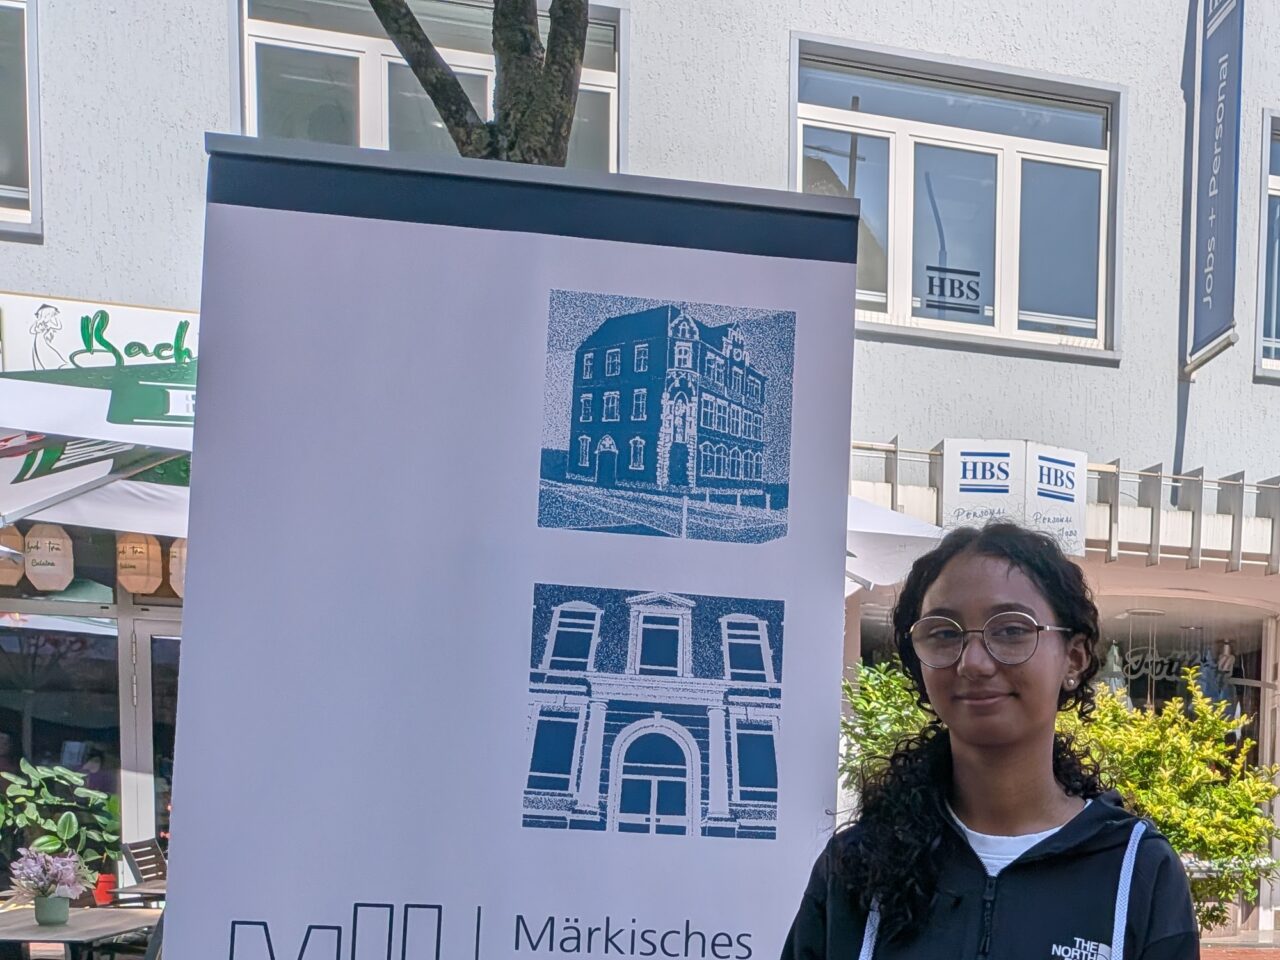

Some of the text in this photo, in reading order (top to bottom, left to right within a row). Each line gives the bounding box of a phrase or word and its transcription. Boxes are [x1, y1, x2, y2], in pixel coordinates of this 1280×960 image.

[1202, 238, 1216, 310] Jobs
[1209, 53, 1229, 198] Personal
[927, 275, 980, 301] HBS
[960, 460, 1010, 481] HBS
[1038, 464, 1075, 490] HBS
[513, 914, 754, 960] Märkisches
[1074, 937, 1099, 954] THE
